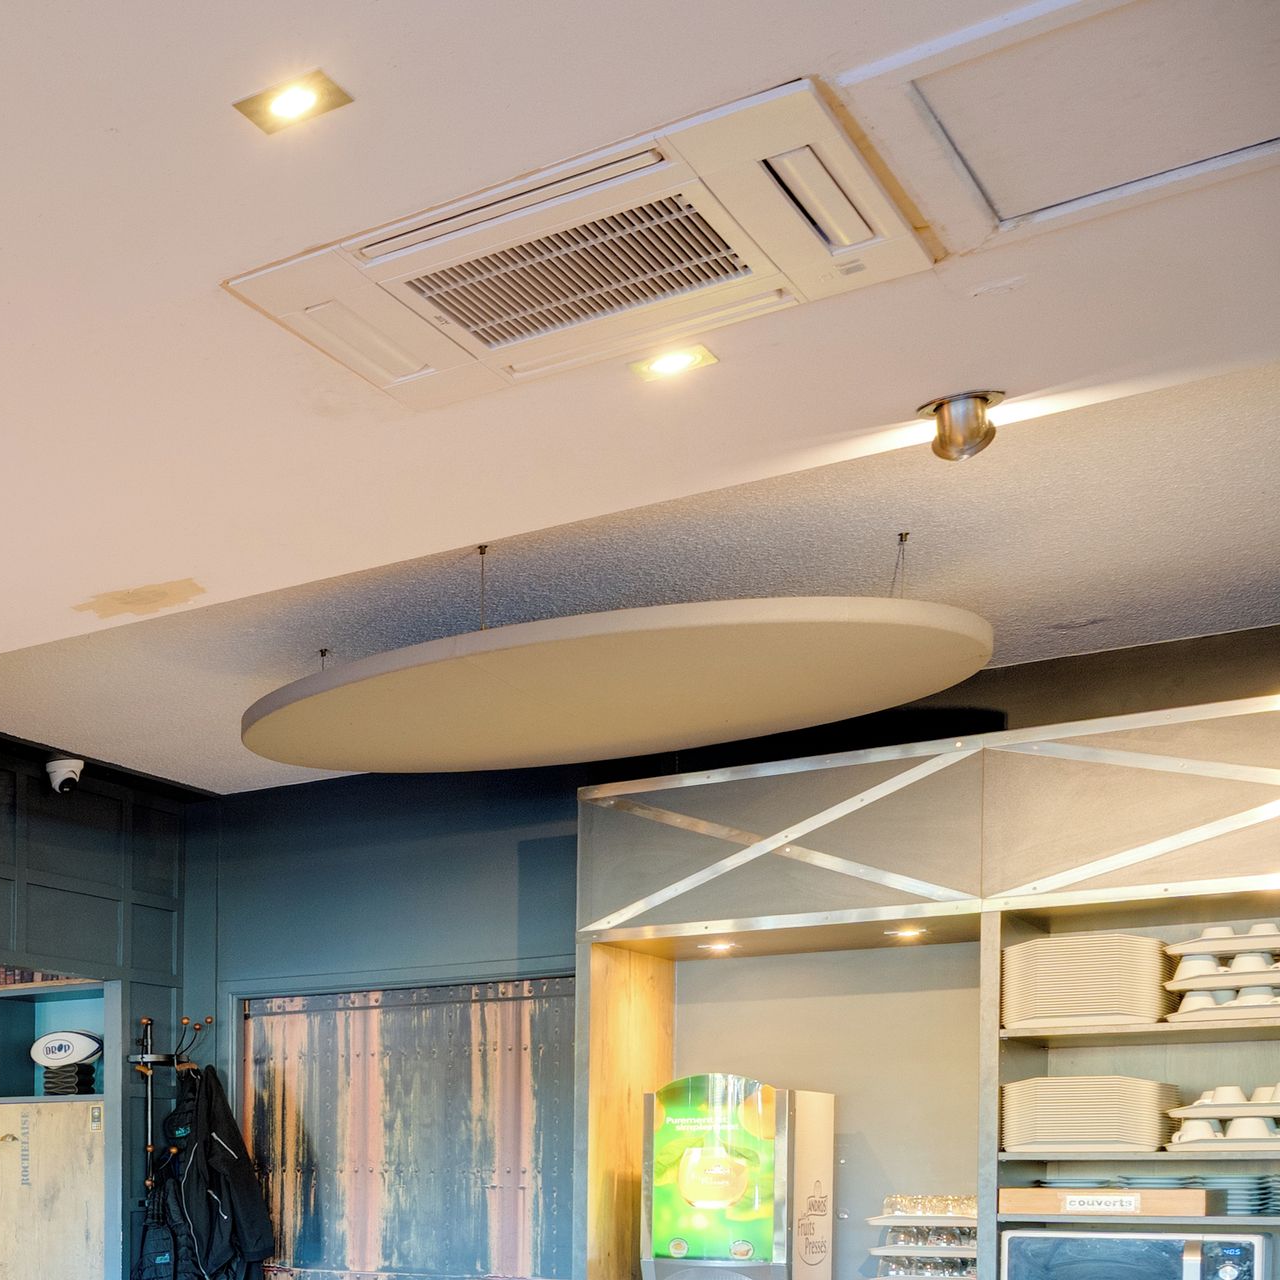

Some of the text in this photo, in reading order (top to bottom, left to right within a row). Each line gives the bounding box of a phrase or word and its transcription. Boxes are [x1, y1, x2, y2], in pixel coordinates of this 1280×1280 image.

[808, 1199, 827, 1213] ANDROS
[1068, 1199, 1133, 1207] couverts
[797, 1217, 815, 1237] Fruits
[805, 1236, 827, 1255] Pressés
